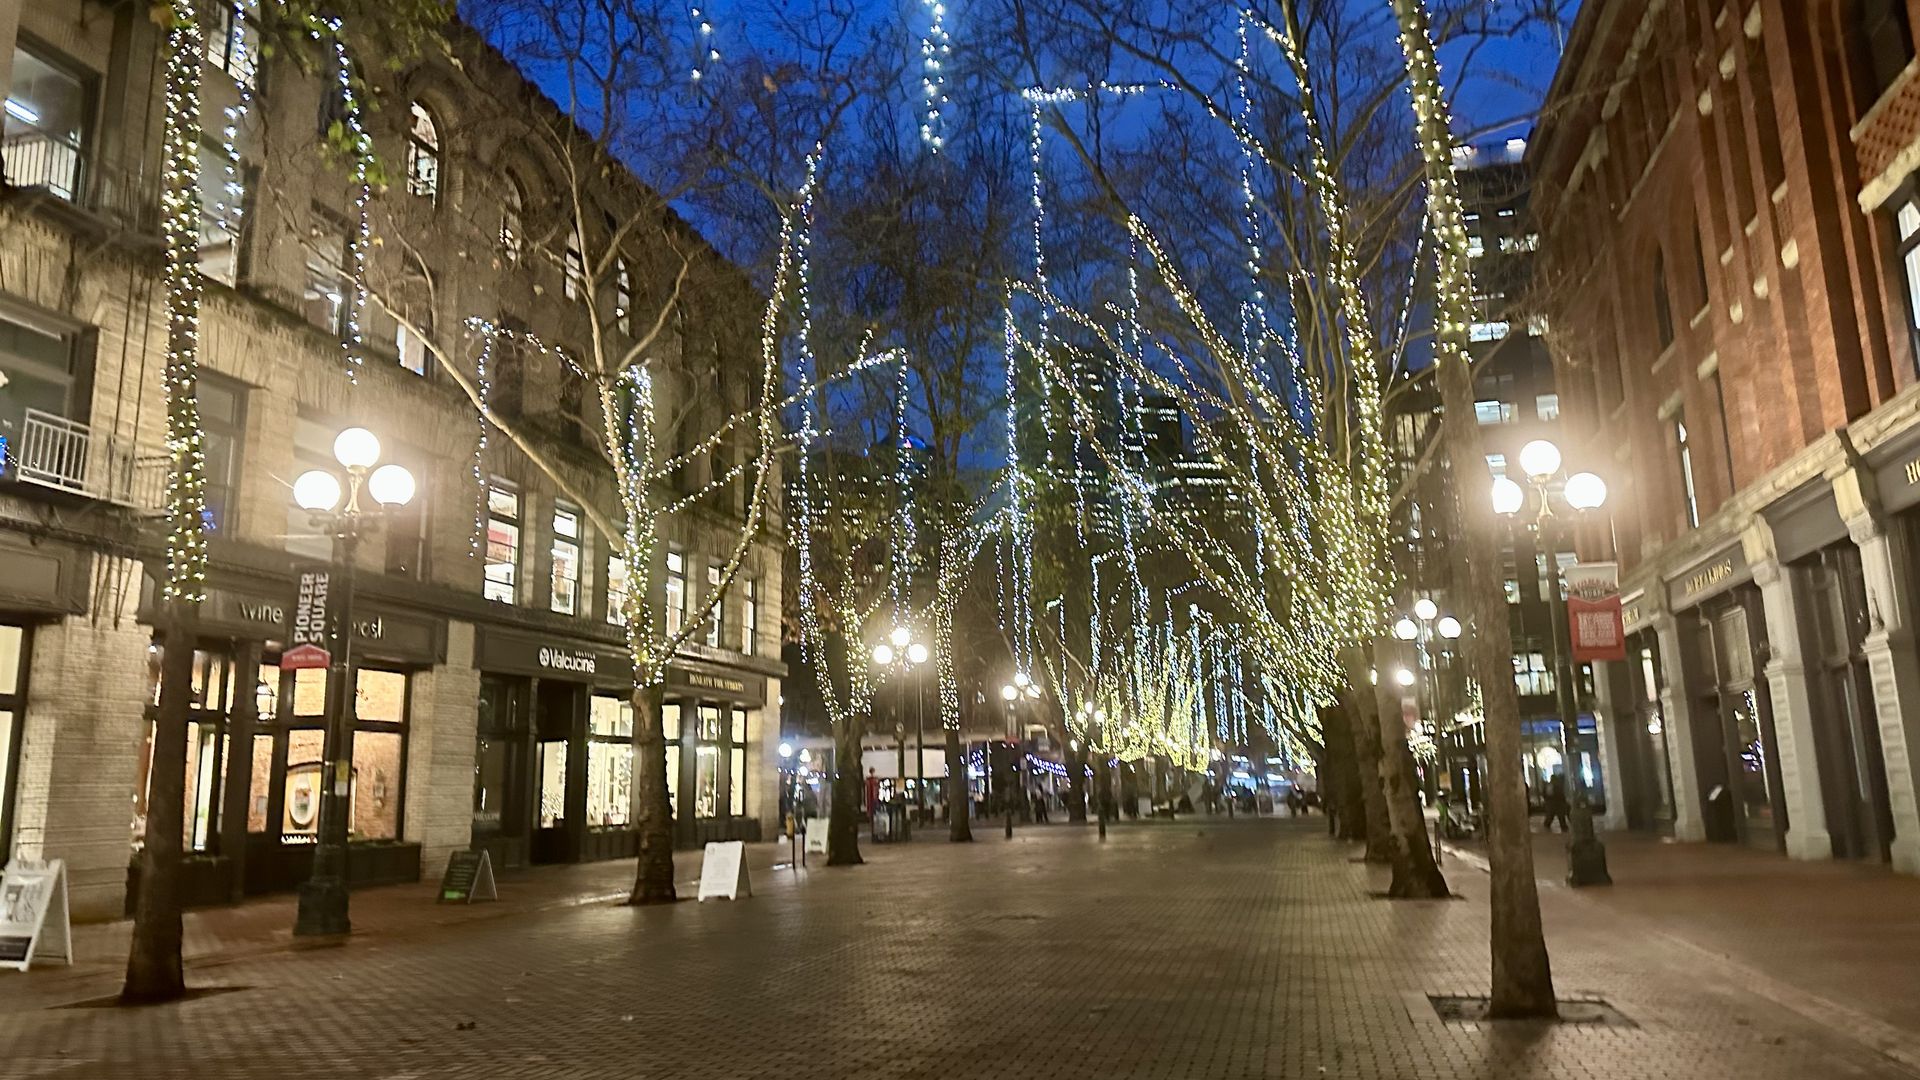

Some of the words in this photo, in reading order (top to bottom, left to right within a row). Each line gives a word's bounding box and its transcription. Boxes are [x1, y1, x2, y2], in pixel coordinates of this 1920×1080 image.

[294, 572, 315, 643] PIONEER
[309, 571, 329, 643] SQUARE
[549, 648, 595, 673] Valcucine
